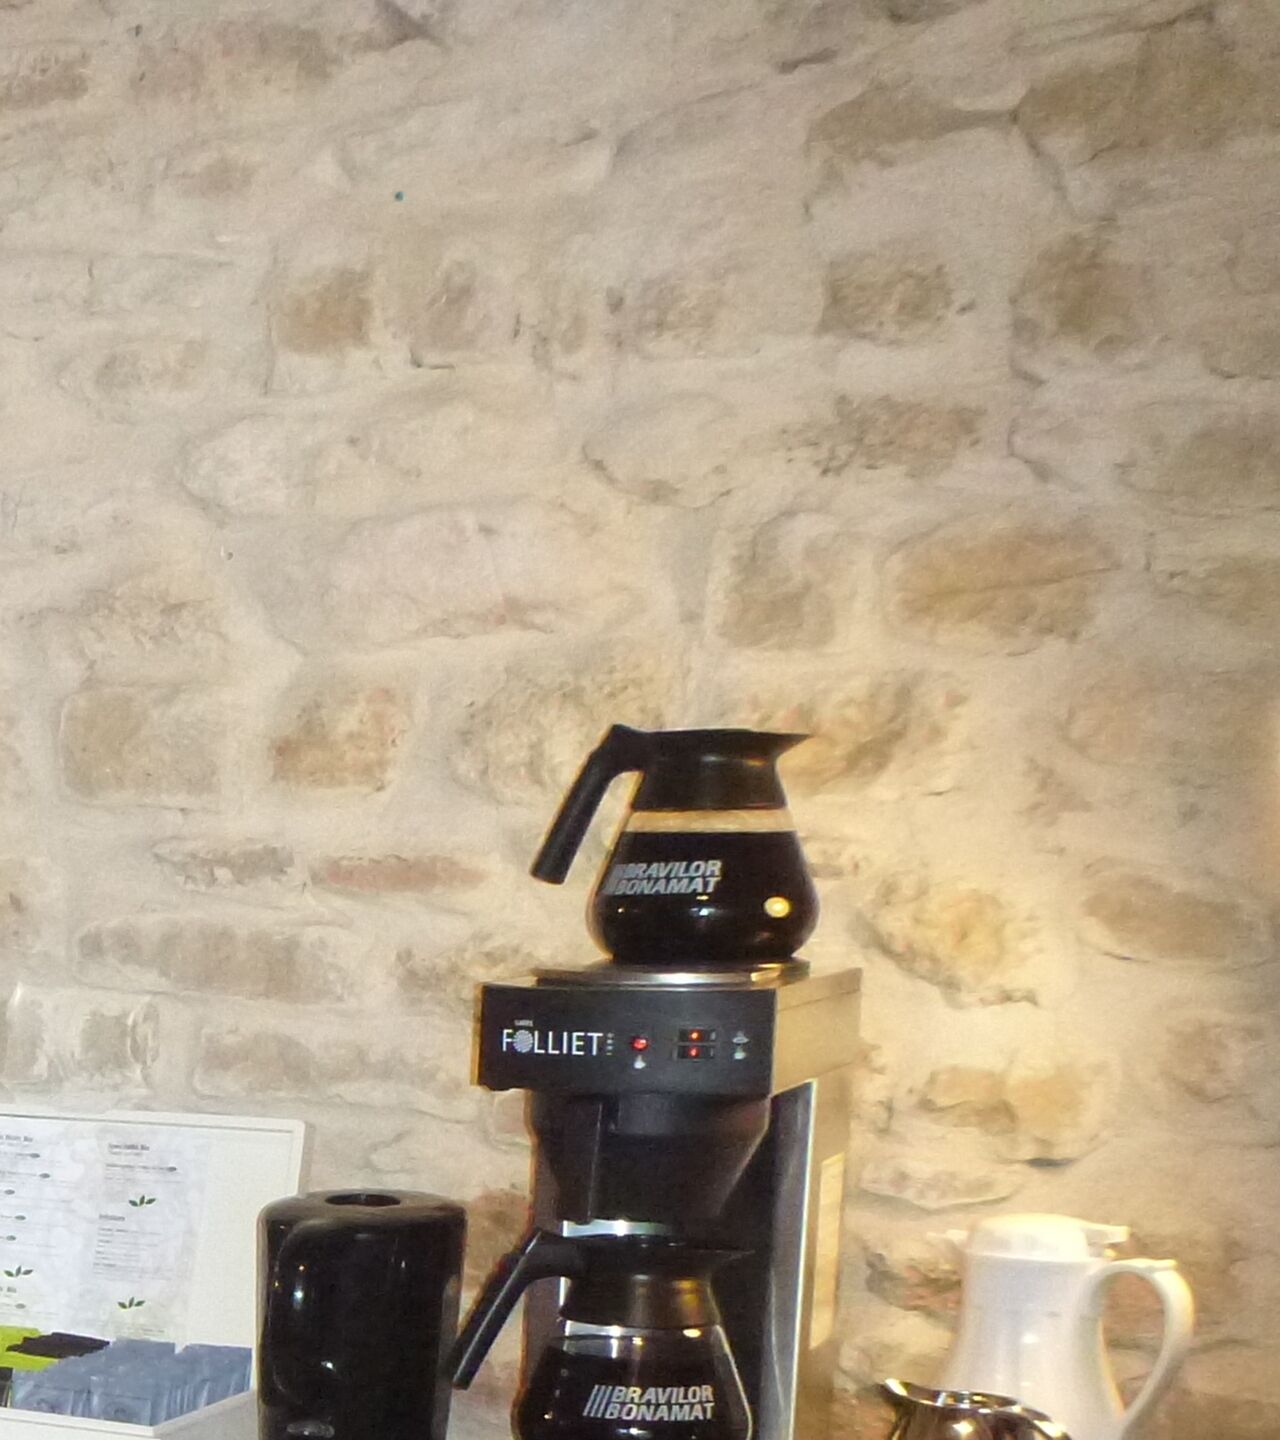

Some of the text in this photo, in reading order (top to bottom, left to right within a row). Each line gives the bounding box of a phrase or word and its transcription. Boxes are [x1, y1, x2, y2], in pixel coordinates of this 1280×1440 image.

[502, 1028, 604, 1056] FOLLIET
[610, 1384, 715, 1404] BRAVILOR
[603, 1401, 716, 1422] BONAMAT
